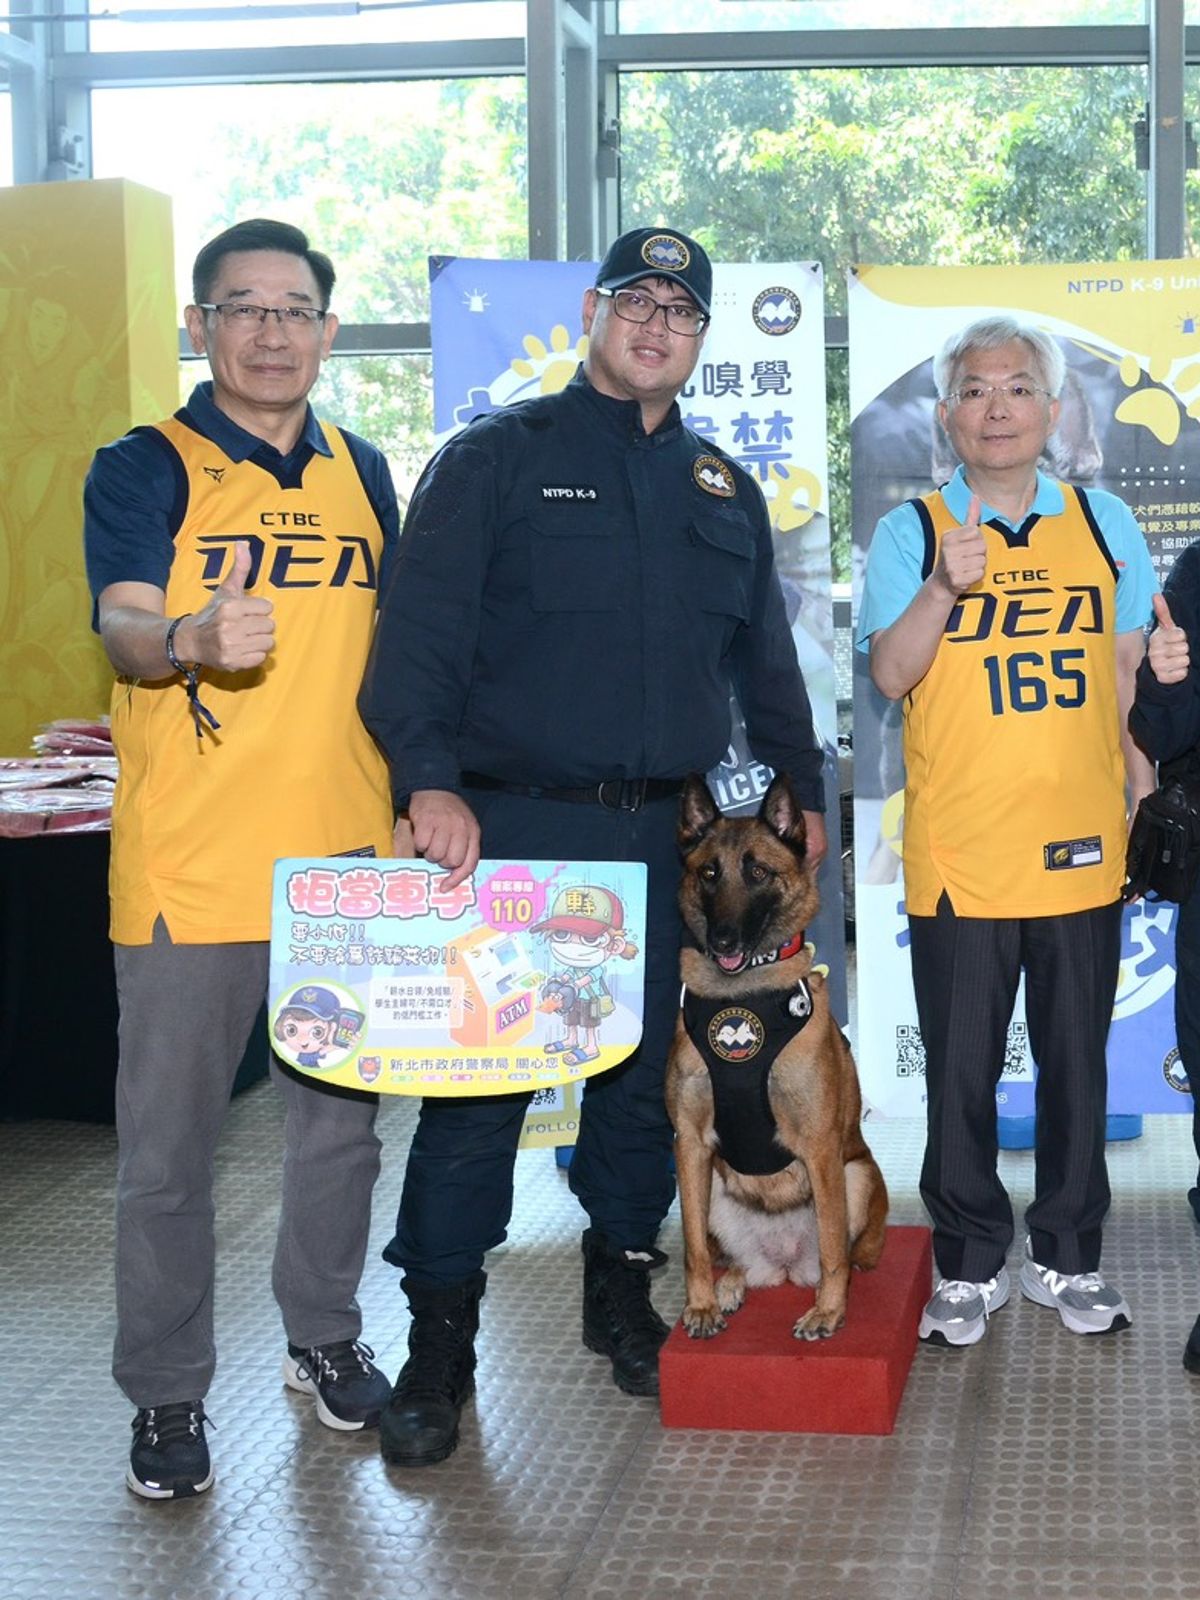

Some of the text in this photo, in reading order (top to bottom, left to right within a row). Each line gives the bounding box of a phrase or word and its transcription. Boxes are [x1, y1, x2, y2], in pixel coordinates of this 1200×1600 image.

[1068, 279, 1123, 293] NTPD
[1131, 277, 1164, 292] K-9
[680, 360, 792, 398] 嗅覺
[542, 488, 597, 499] NTPD K-9
[260, 512, 321, 526] CTBC
[196, 534, 377, 590] DEA
[992, 569, 1049, 585] CTBC
[943, 586, 1104, 643] DEA
[983, 648, 1086, 716] 165
[716, 764, 769, 806] ICE
[288, 870, 475, 918] 拒當車手
[491, 898, 533, 923] 110
[500, 998, 530, 1030] ATM
[390, 1058, 509, 1071] 新北市政府警察局
